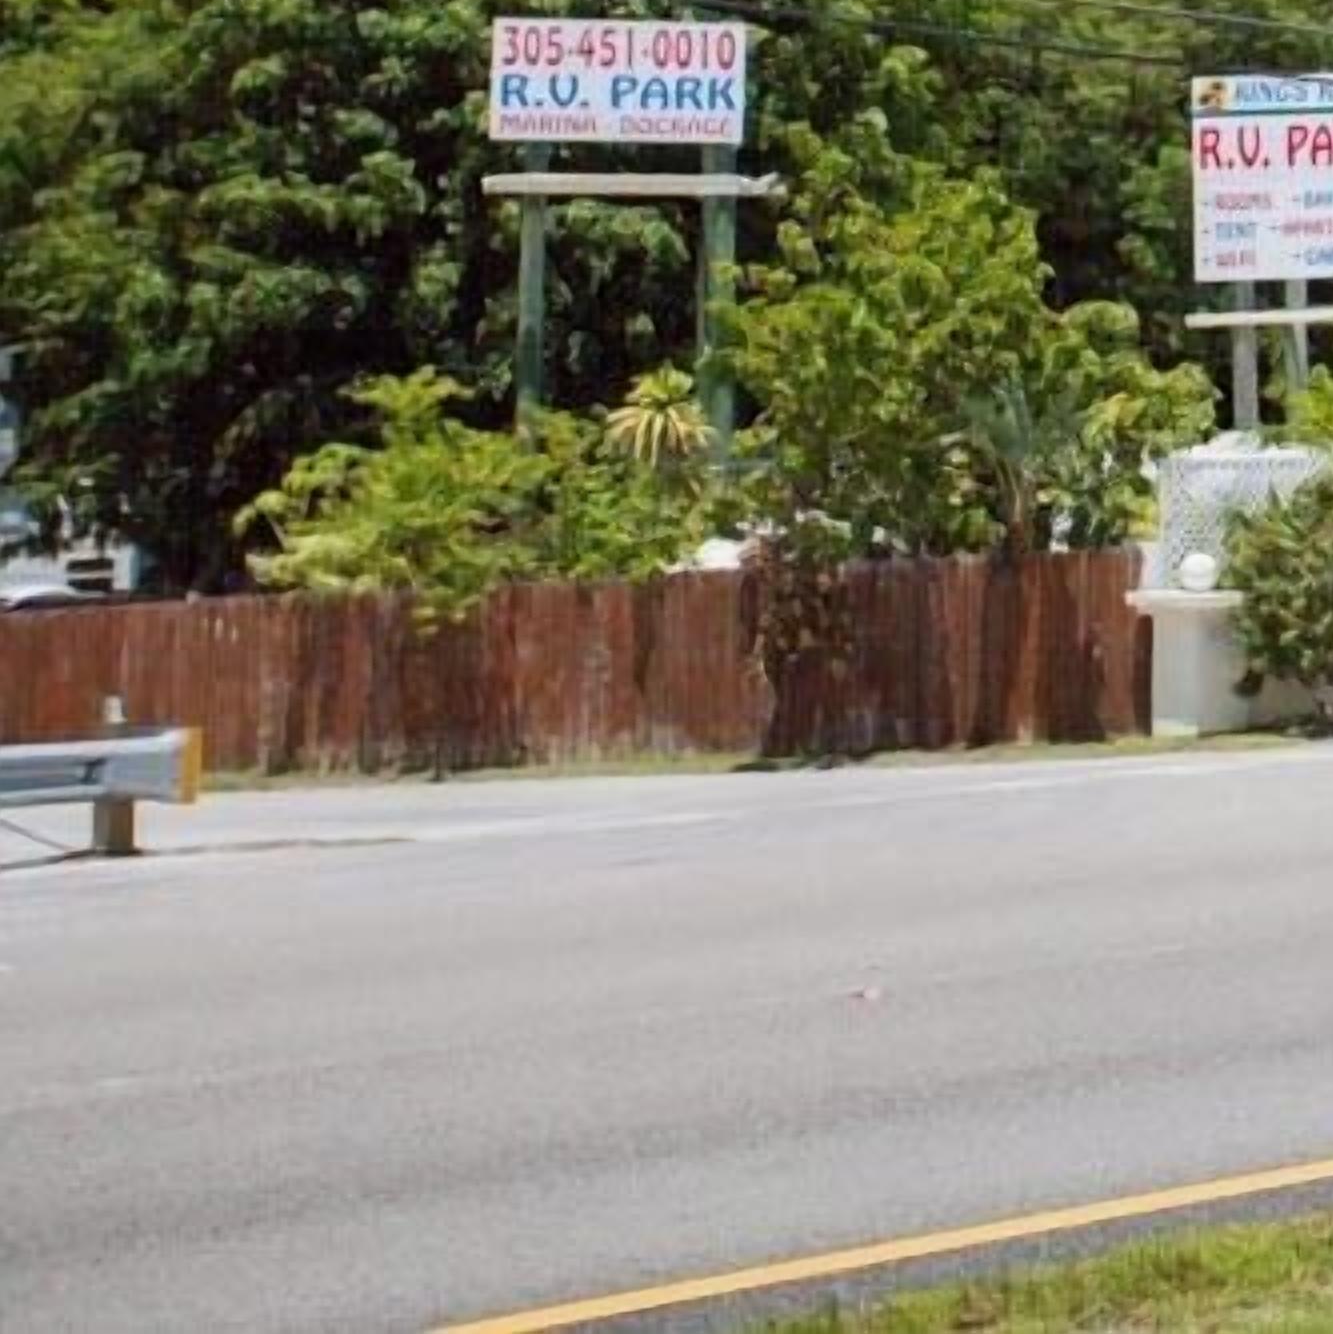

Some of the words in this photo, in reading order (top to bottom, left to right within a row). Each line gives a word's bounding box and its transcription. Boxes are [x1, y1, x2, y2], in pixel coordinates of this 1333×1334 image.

[501, 73, 589, 107] R.V.
[611, 75, 736, 110] PARK
[1200, 121, 1271, 169] R.V.
